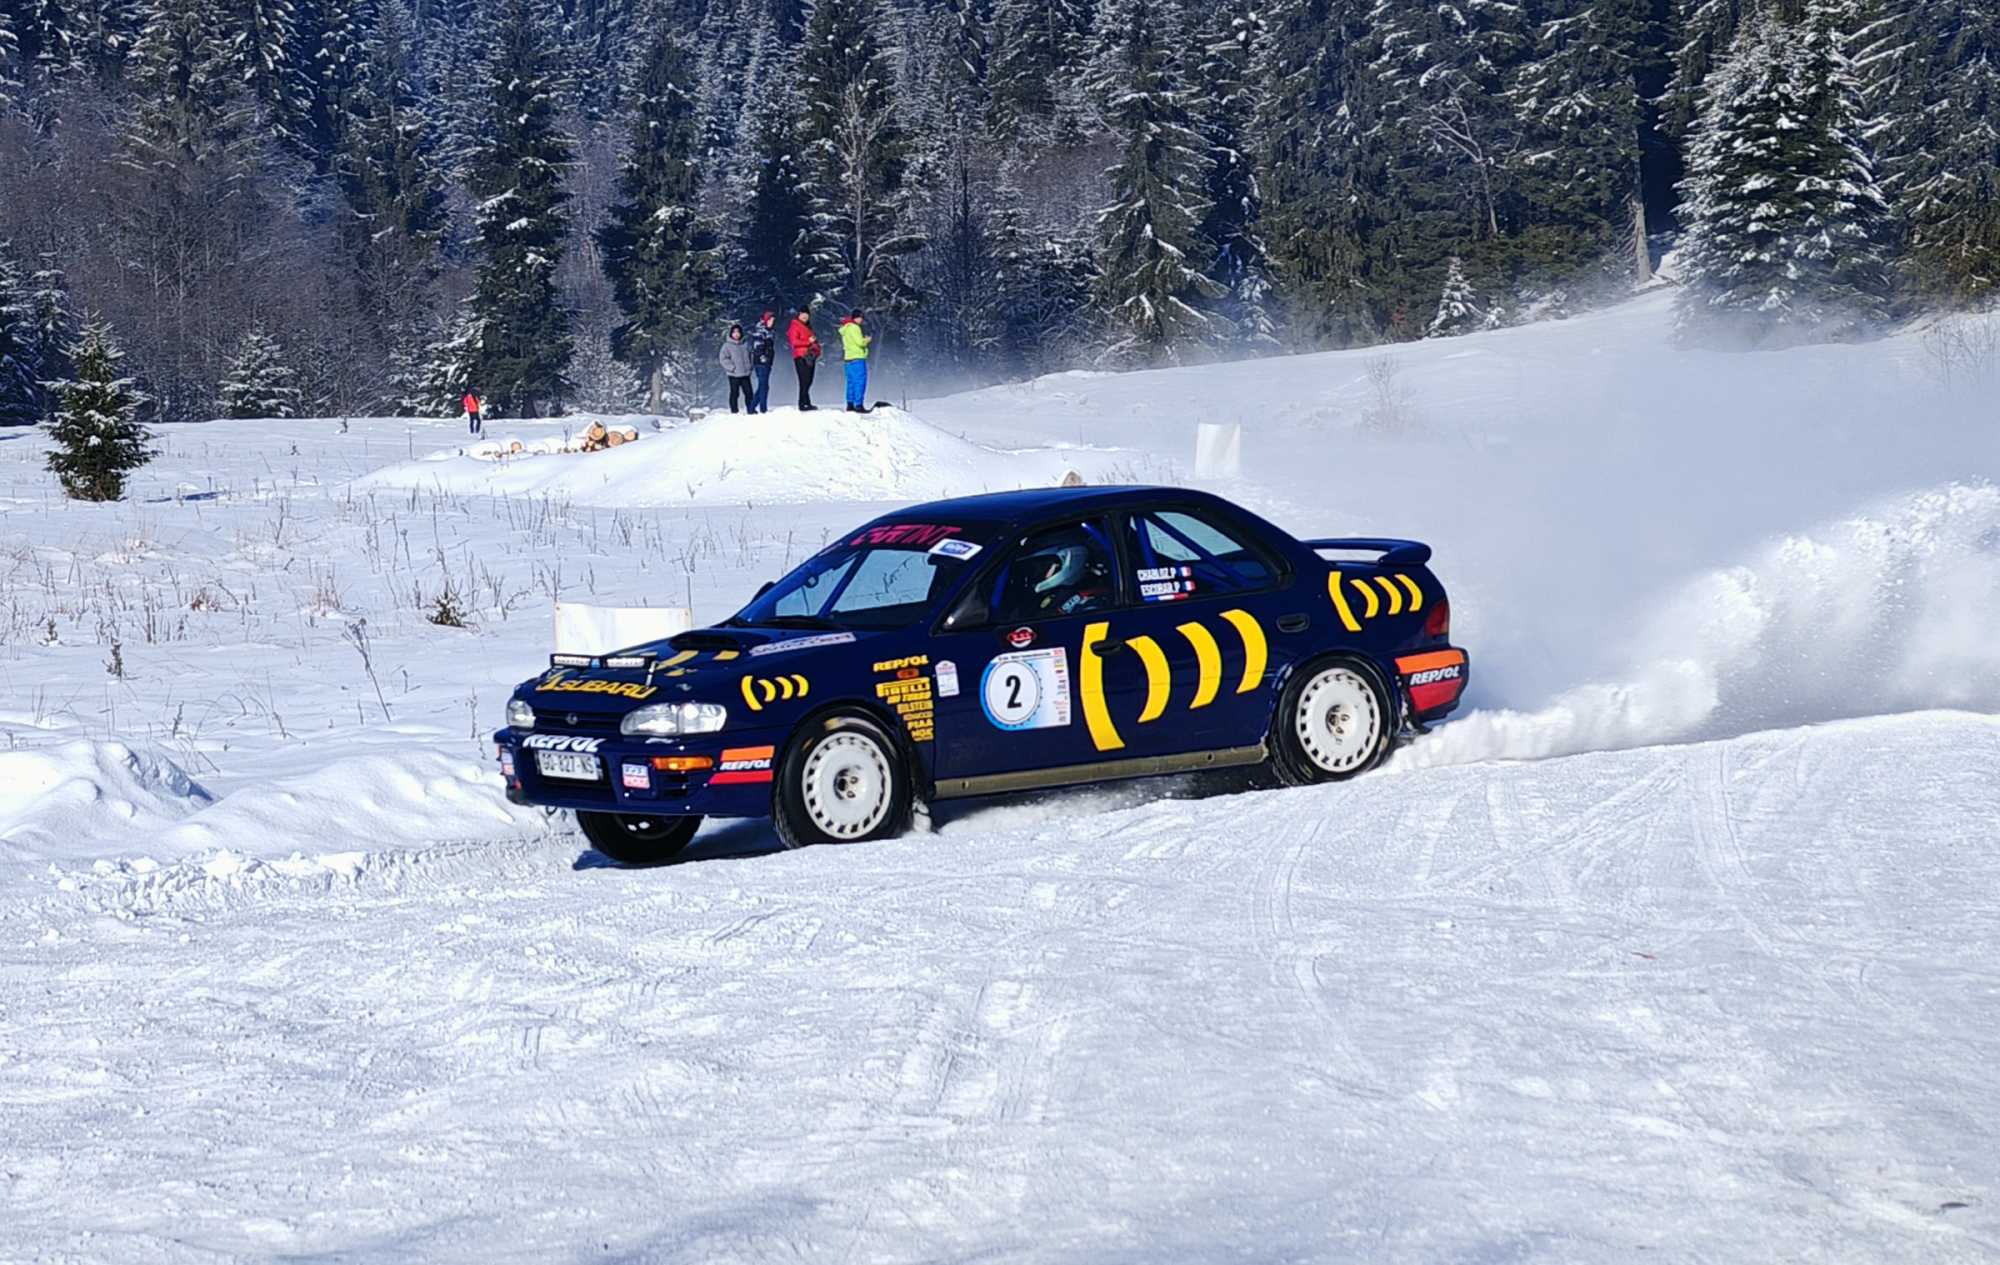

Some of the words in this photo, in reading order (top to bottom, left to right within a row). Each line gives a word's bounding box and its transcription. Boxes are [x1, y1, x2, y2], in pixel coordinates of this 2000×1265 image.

[873, 654, 929, 673] REPSOL
[1409, 665, 1460, 686] REPSOL
[557, 678, 658, 700] SUBARU
[875, 676, 931, 698] PIRELLI
[1005, 675, 1022, 709] 2
[522, 734, 607, 753] REPSOL
[719, 758, 772, 771] REPSOL
